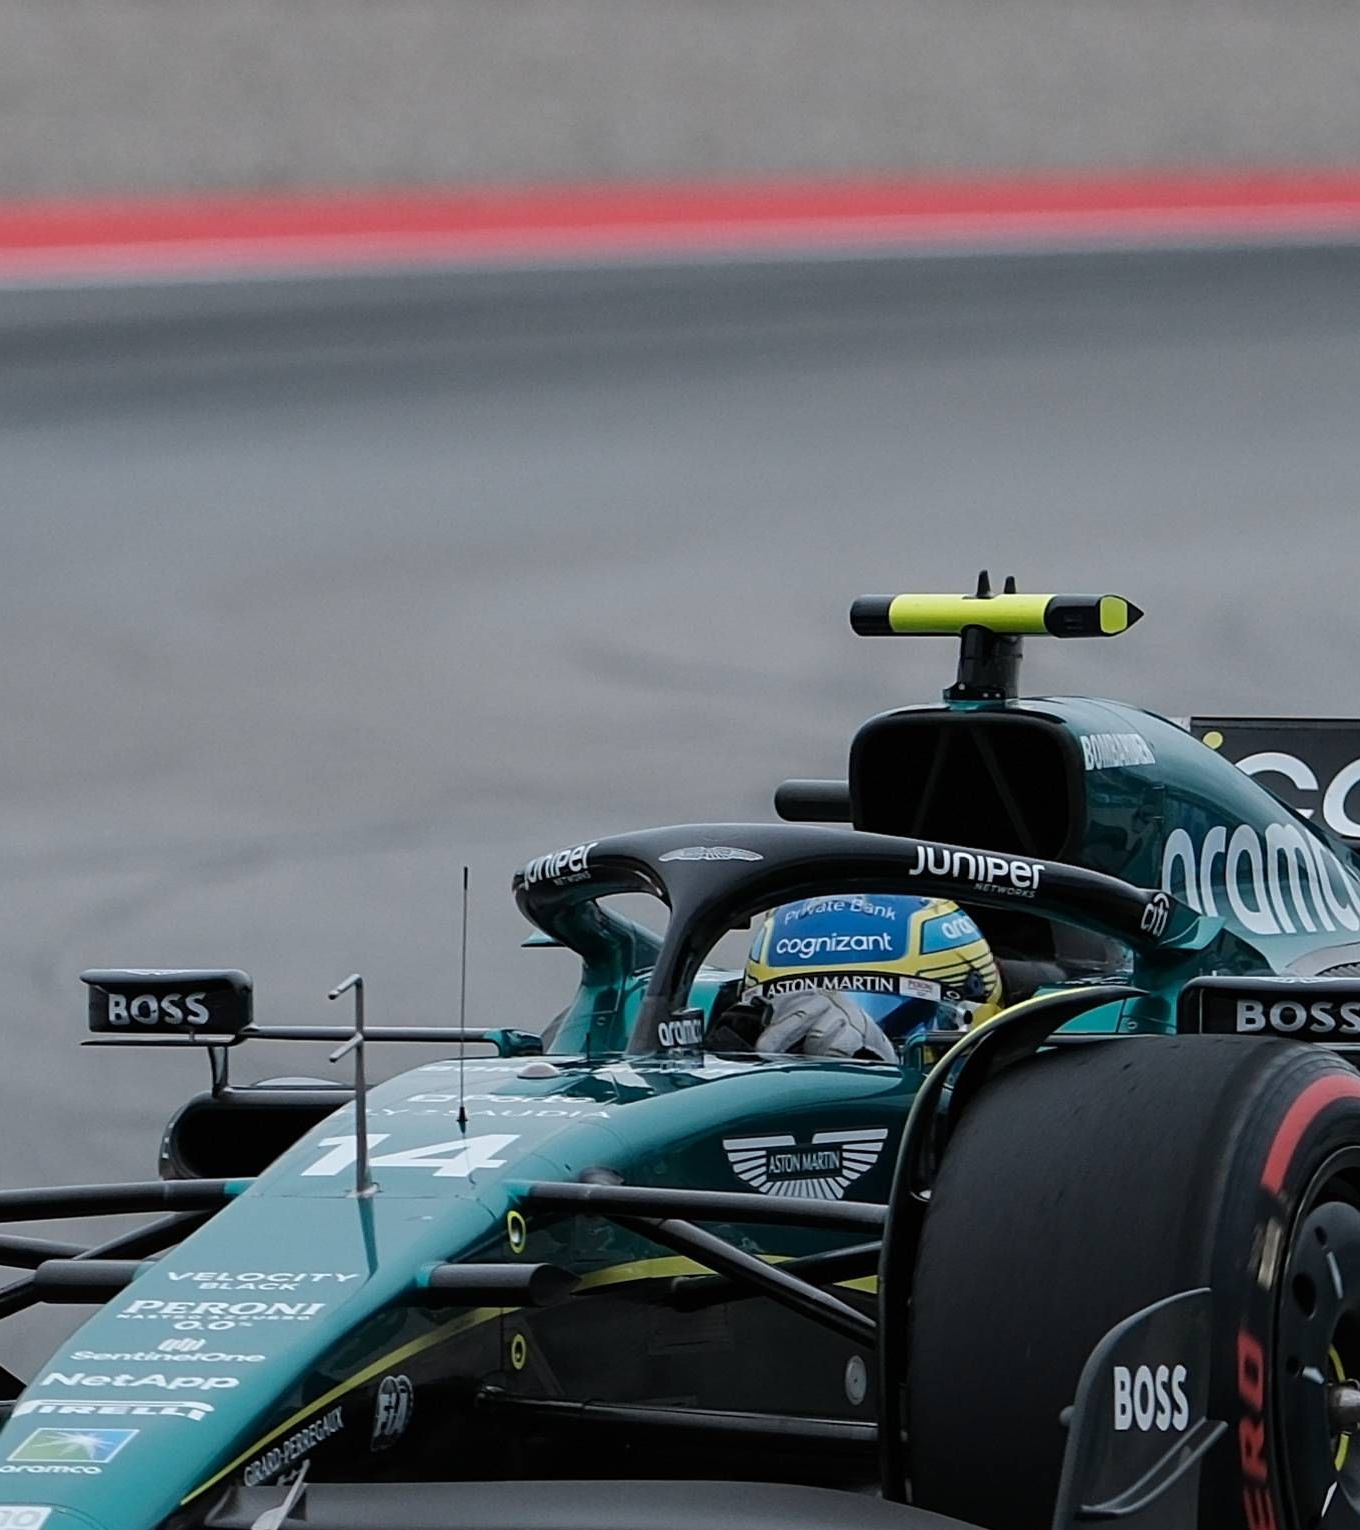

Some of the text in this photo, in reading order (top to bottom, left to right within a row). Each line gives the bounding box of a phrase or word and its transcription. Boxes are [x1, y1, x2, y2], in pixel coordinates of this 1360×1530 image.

[974, 882, 1036, 898] NETWORKS
[849, 895, 897, 921] Bank
[1140, 892, 1170, 937] citi
[776, 931, 894, 959] cognizant
[767, 976, 818, 998] ASTON
[822, 974, 894, 993] MARTIN
[108, 992, 210, 1026] BOSS
[657, 1018, 702, 1047] aramc
[300, 1133, 521, 1178] 14
[768, 1151, 840, 1174] ASTON MARTIN
[167, 1271, 360, 1282] VELOCITY
[198, 1281, 298, 1291] BLACK
[122, 1300, 326, 1315] PERONI
[70, 1350, 266, 1363] SentinelOne
[42, 1372, 239, 1390] NetApp
[1113, 1364, 1191, 1432] BOSS
[11, 1399, 215, 1422] PIRELLI
